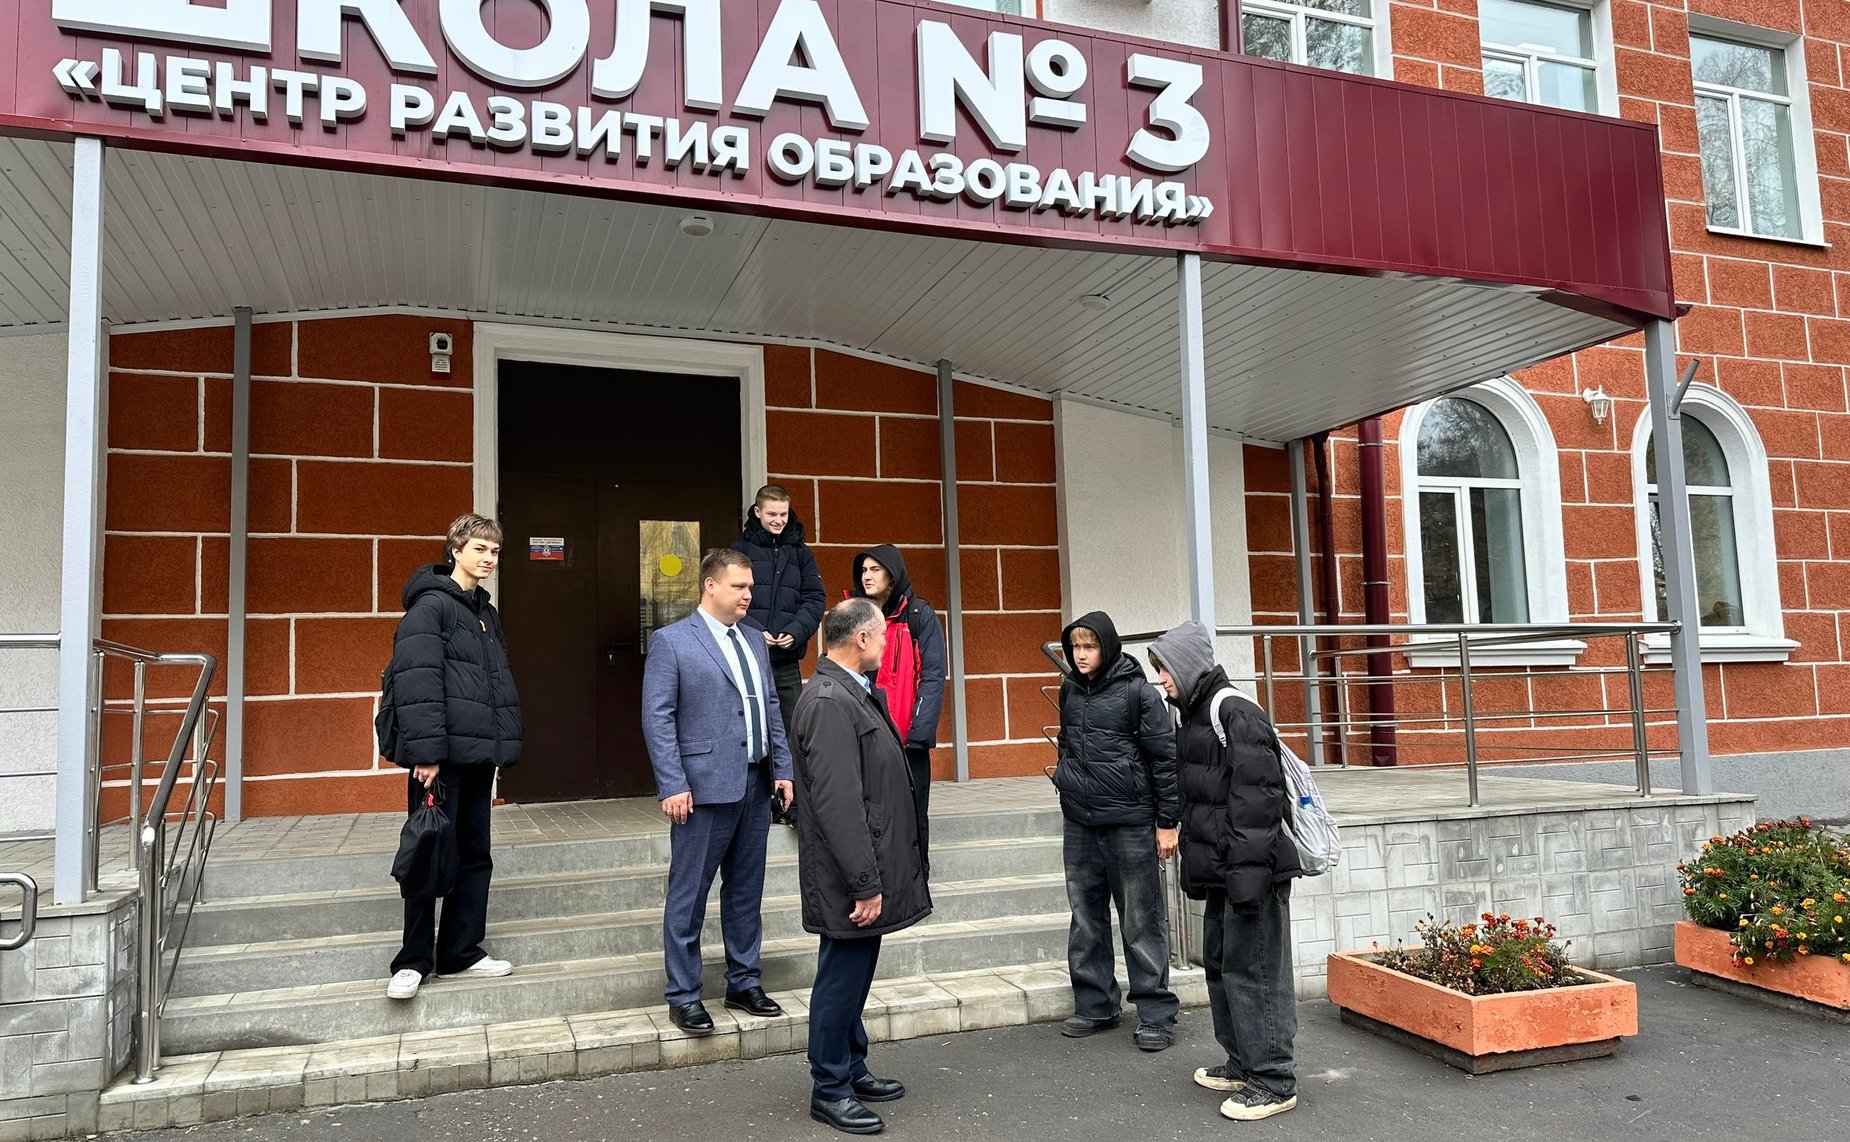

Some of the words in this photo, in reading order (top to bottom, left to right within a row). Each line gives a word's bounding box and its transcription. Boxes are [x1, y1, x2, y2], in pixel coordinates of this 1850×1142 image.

[52, 0, 870, 132] ОЛА
[917, 19, 1087, 153] №
[1126, 53, 1211, 172] 3
[52, 47, 367, 129] «ЦЕНТР
[390, 83, 749, 176] РАЗВИТИЯ
[767, 132, 1214, 224] ОБРАЗОВАНИЯ»
